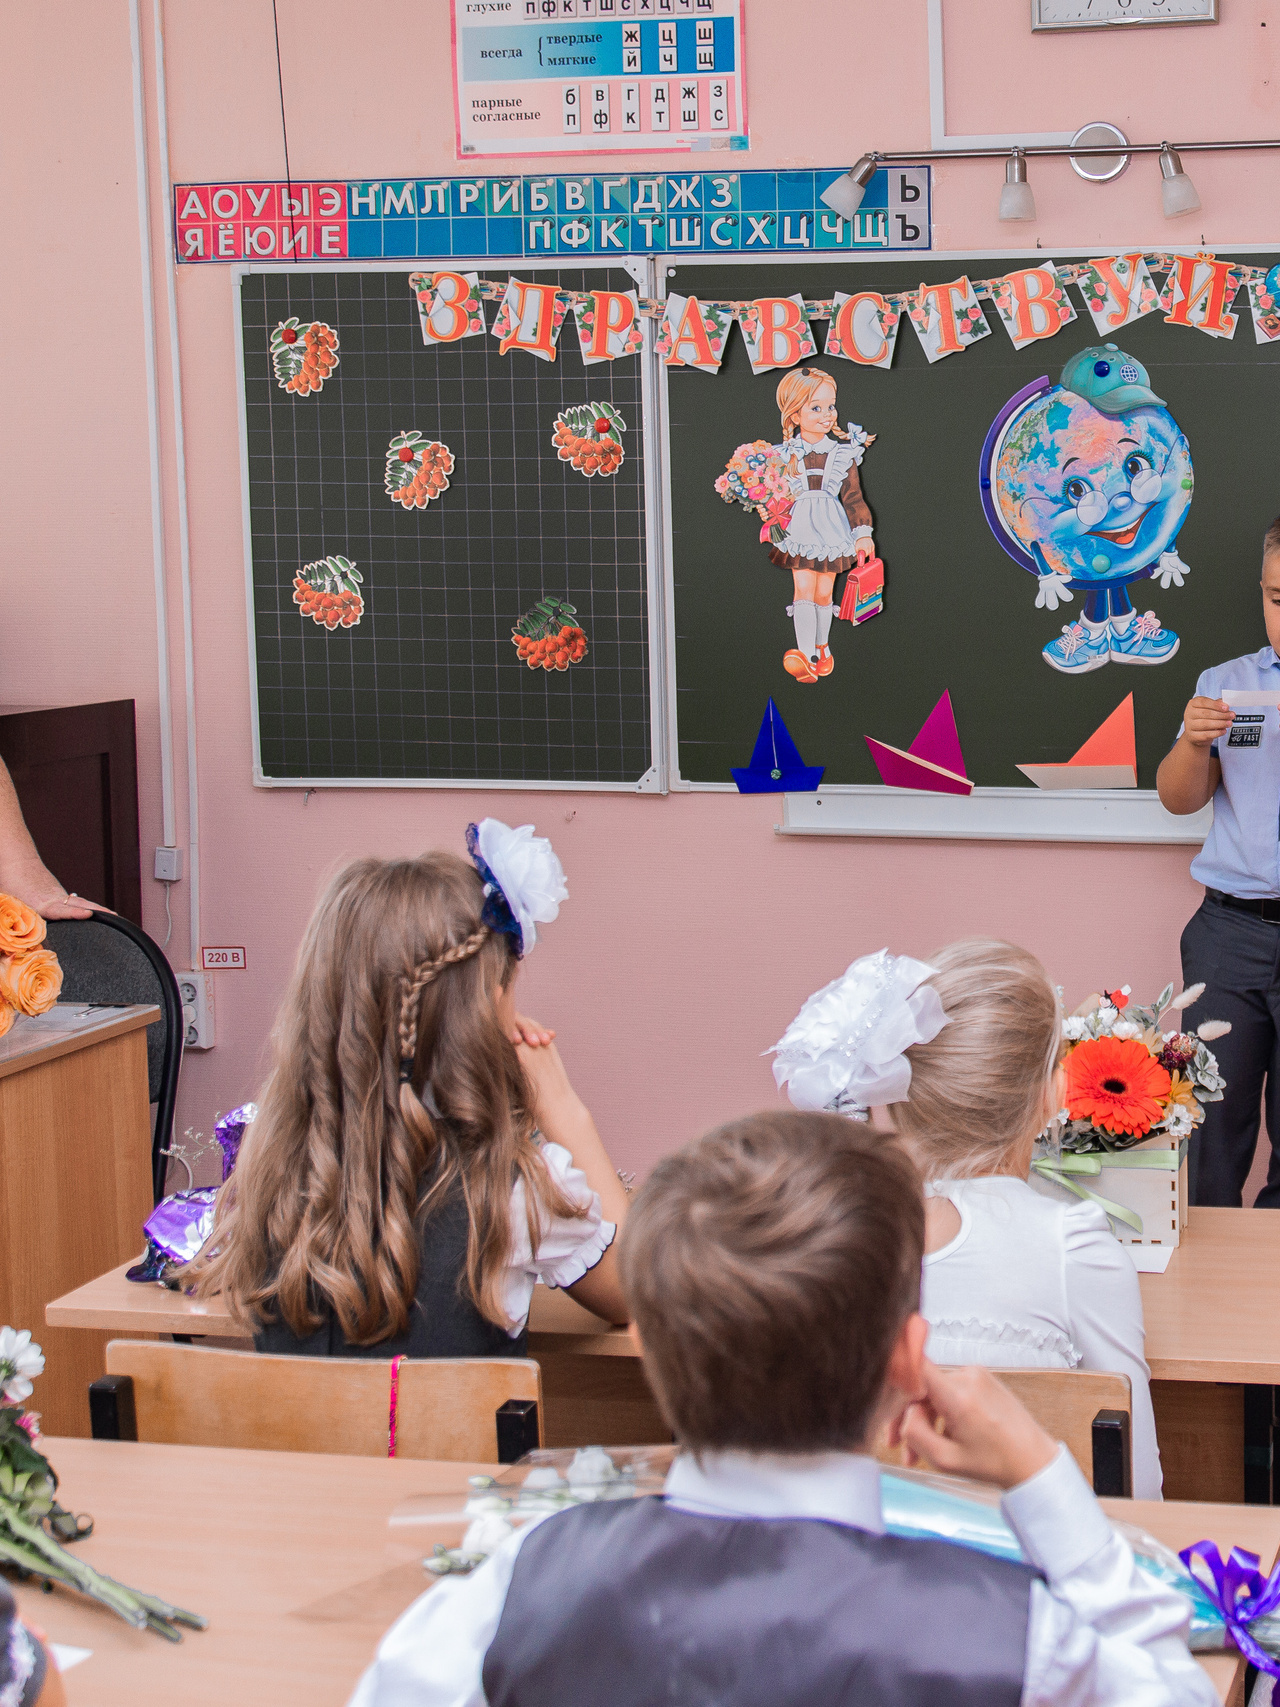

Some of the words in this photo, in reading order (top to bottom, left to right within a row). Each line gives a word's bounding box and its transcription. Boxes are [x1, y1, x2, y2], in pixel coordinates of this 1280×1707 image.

[466, 1, 511, 14] глухие
[547, 34, 603, 46] твердые
[481, 49, 522, 59] всегда
[548, 56, 596, 66] мягкие
[472, 99, 522, 110] парные
[473, 112, 541, 122] согласные
[208, 953, 228, 962] 220
